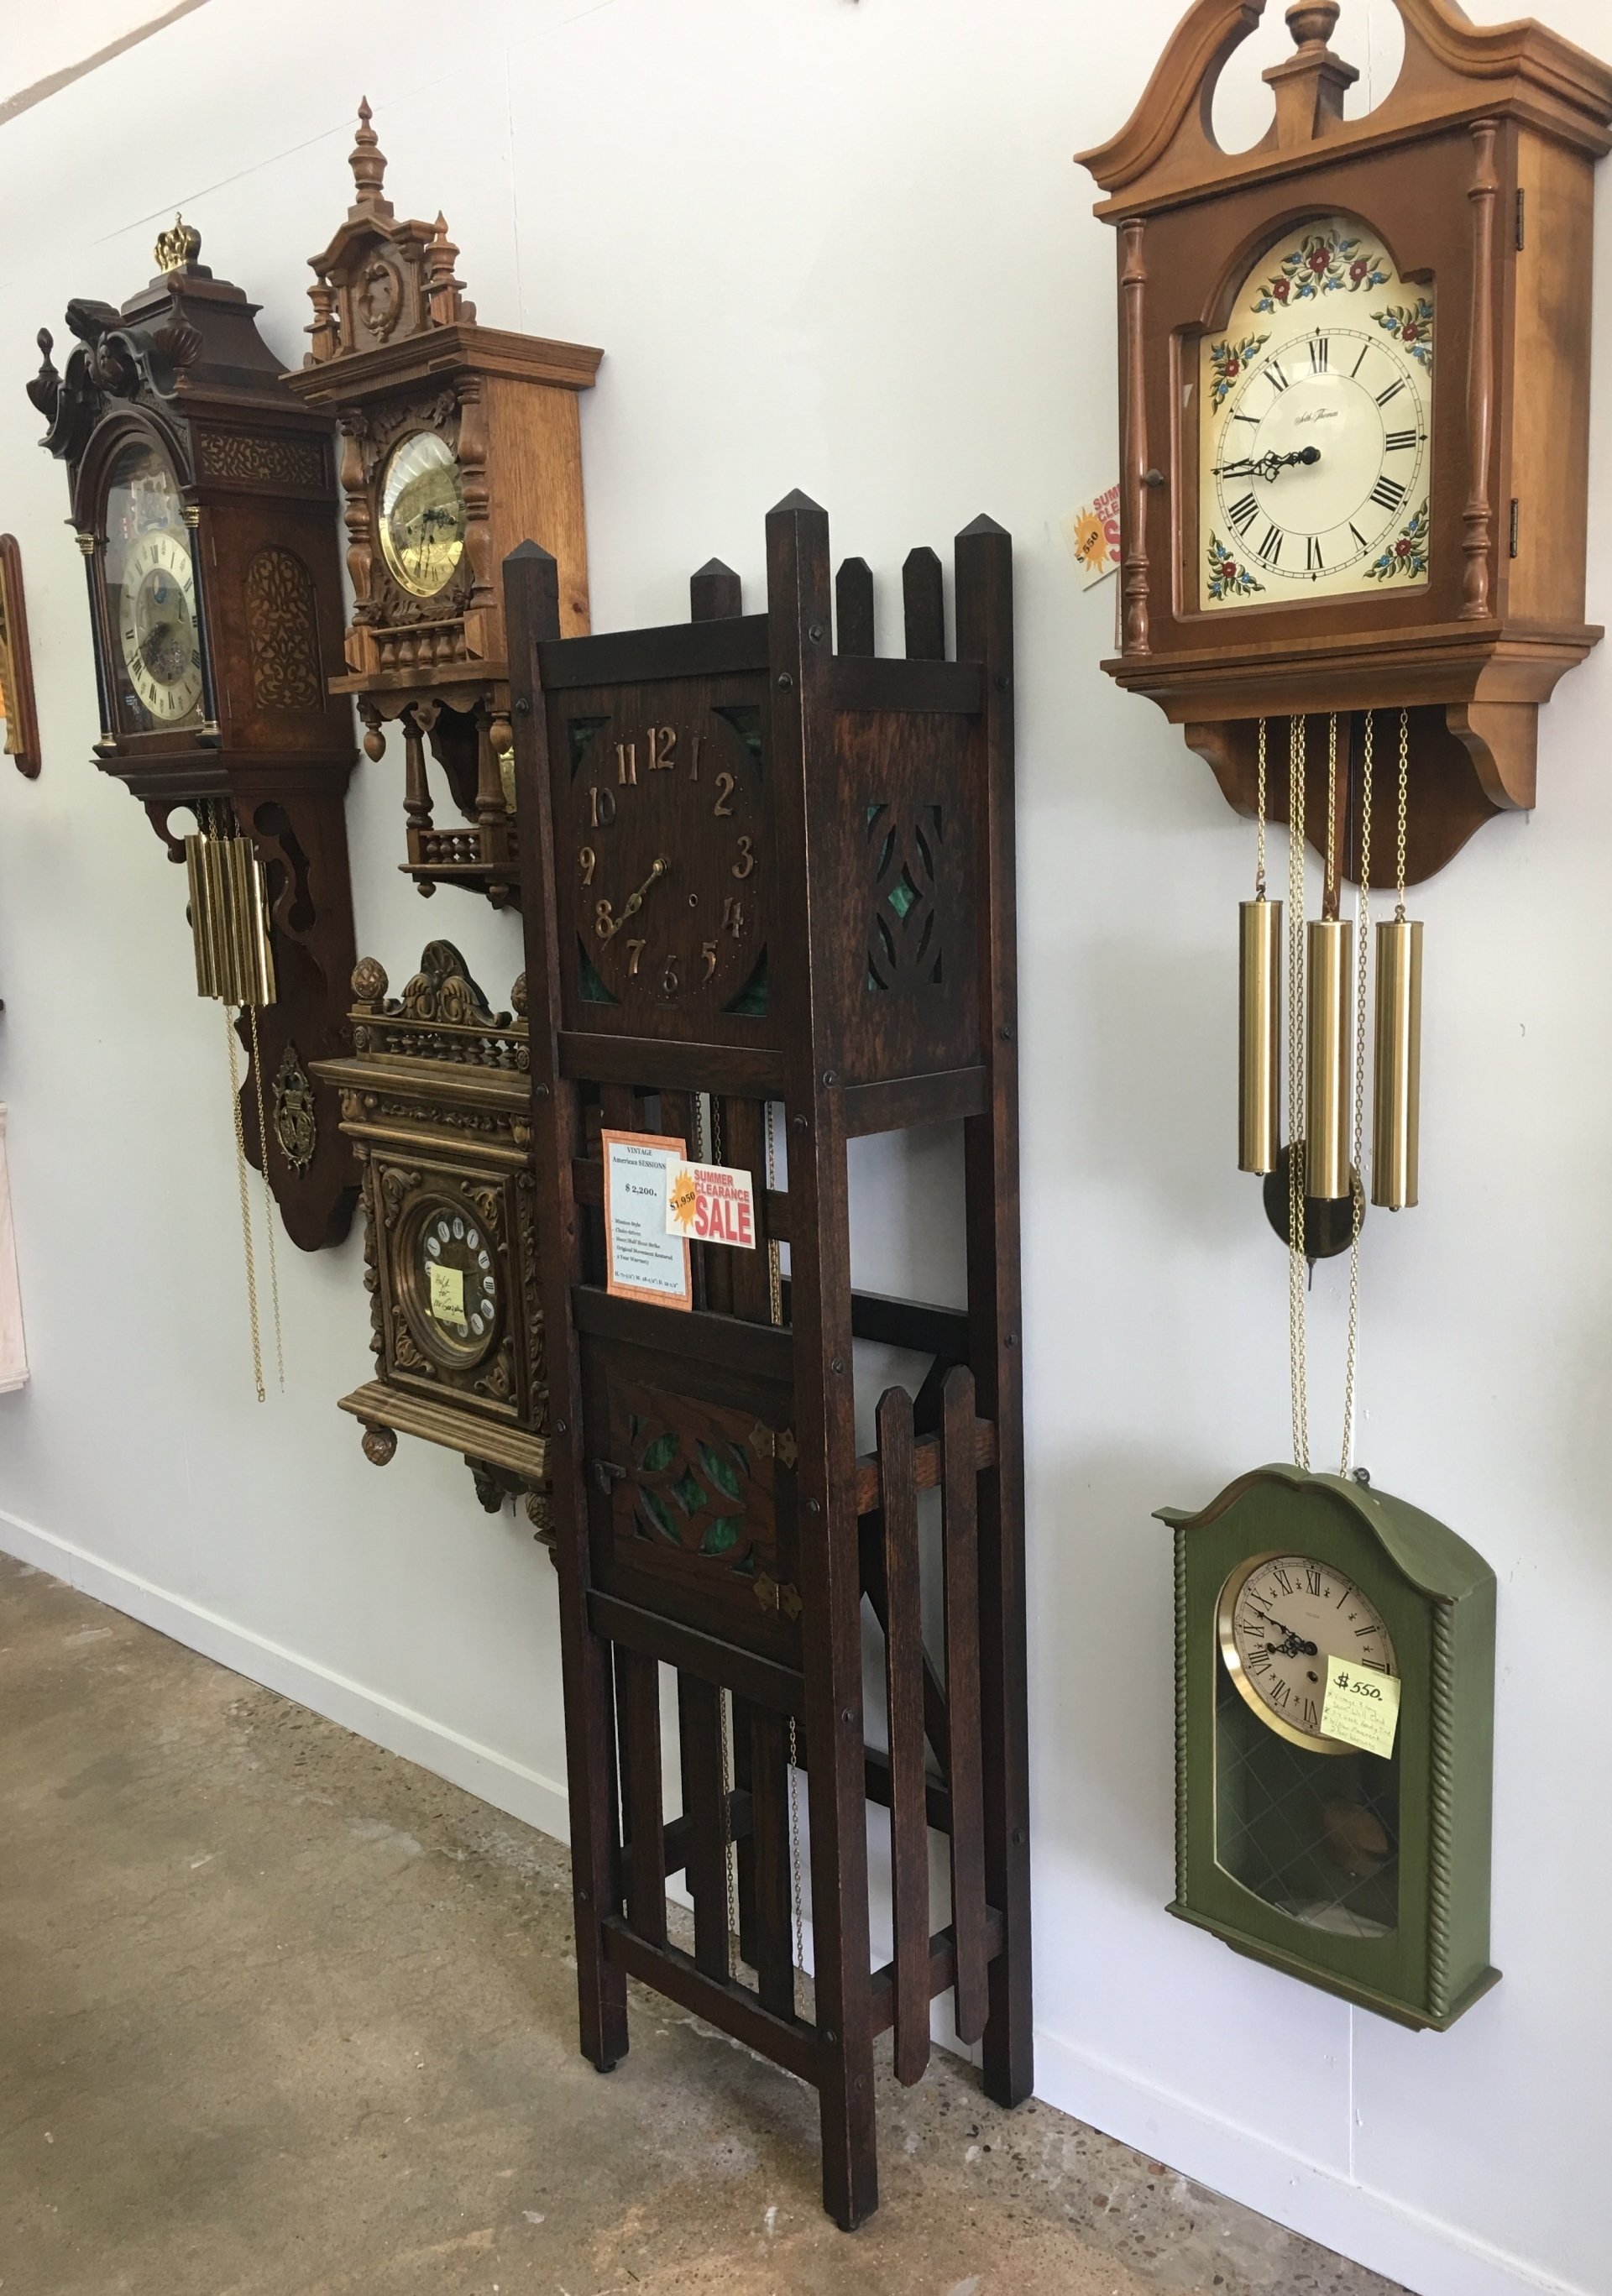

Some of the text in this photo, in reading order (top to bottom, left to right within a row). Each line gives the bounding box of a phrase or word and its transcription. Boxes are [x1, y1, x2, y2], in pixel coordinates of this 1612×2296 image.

[1306, 338, 1329, 374] XII
[1385, 427, 1416, 454] III
[615, 743, 637, 786] 11
[646, 726, 677, 771] 12
[690, 737, 700, 782] 1
[589, 787, 617, 828] 10
[714, 771, 735, 817] 2
[579, 846, 596, 886] 9
[731, 835, 754, 879] 3
[595, 899, 615, 939] 8
[722, 897, 744, 939] 4
[625, 939, 646, 977] 7
[663, 955, 678, 993] 6
[702, 939, 719, 982] 5
[613, 1156, 666, 1169] American SESSIONS
[627, 1147, 652, 1156] VINTAGE
[625, 1183, 657, 1196] $ 2,200.
[694, 1169, 733, 1186] SUMMER
[695, 1182, 750, 1202] CLEARANCE
[670, 1191, 695, 1211] $1,950
[695, 1195, 751, 1244] SALE
[1306, 1569, 1321, 1597] XII
